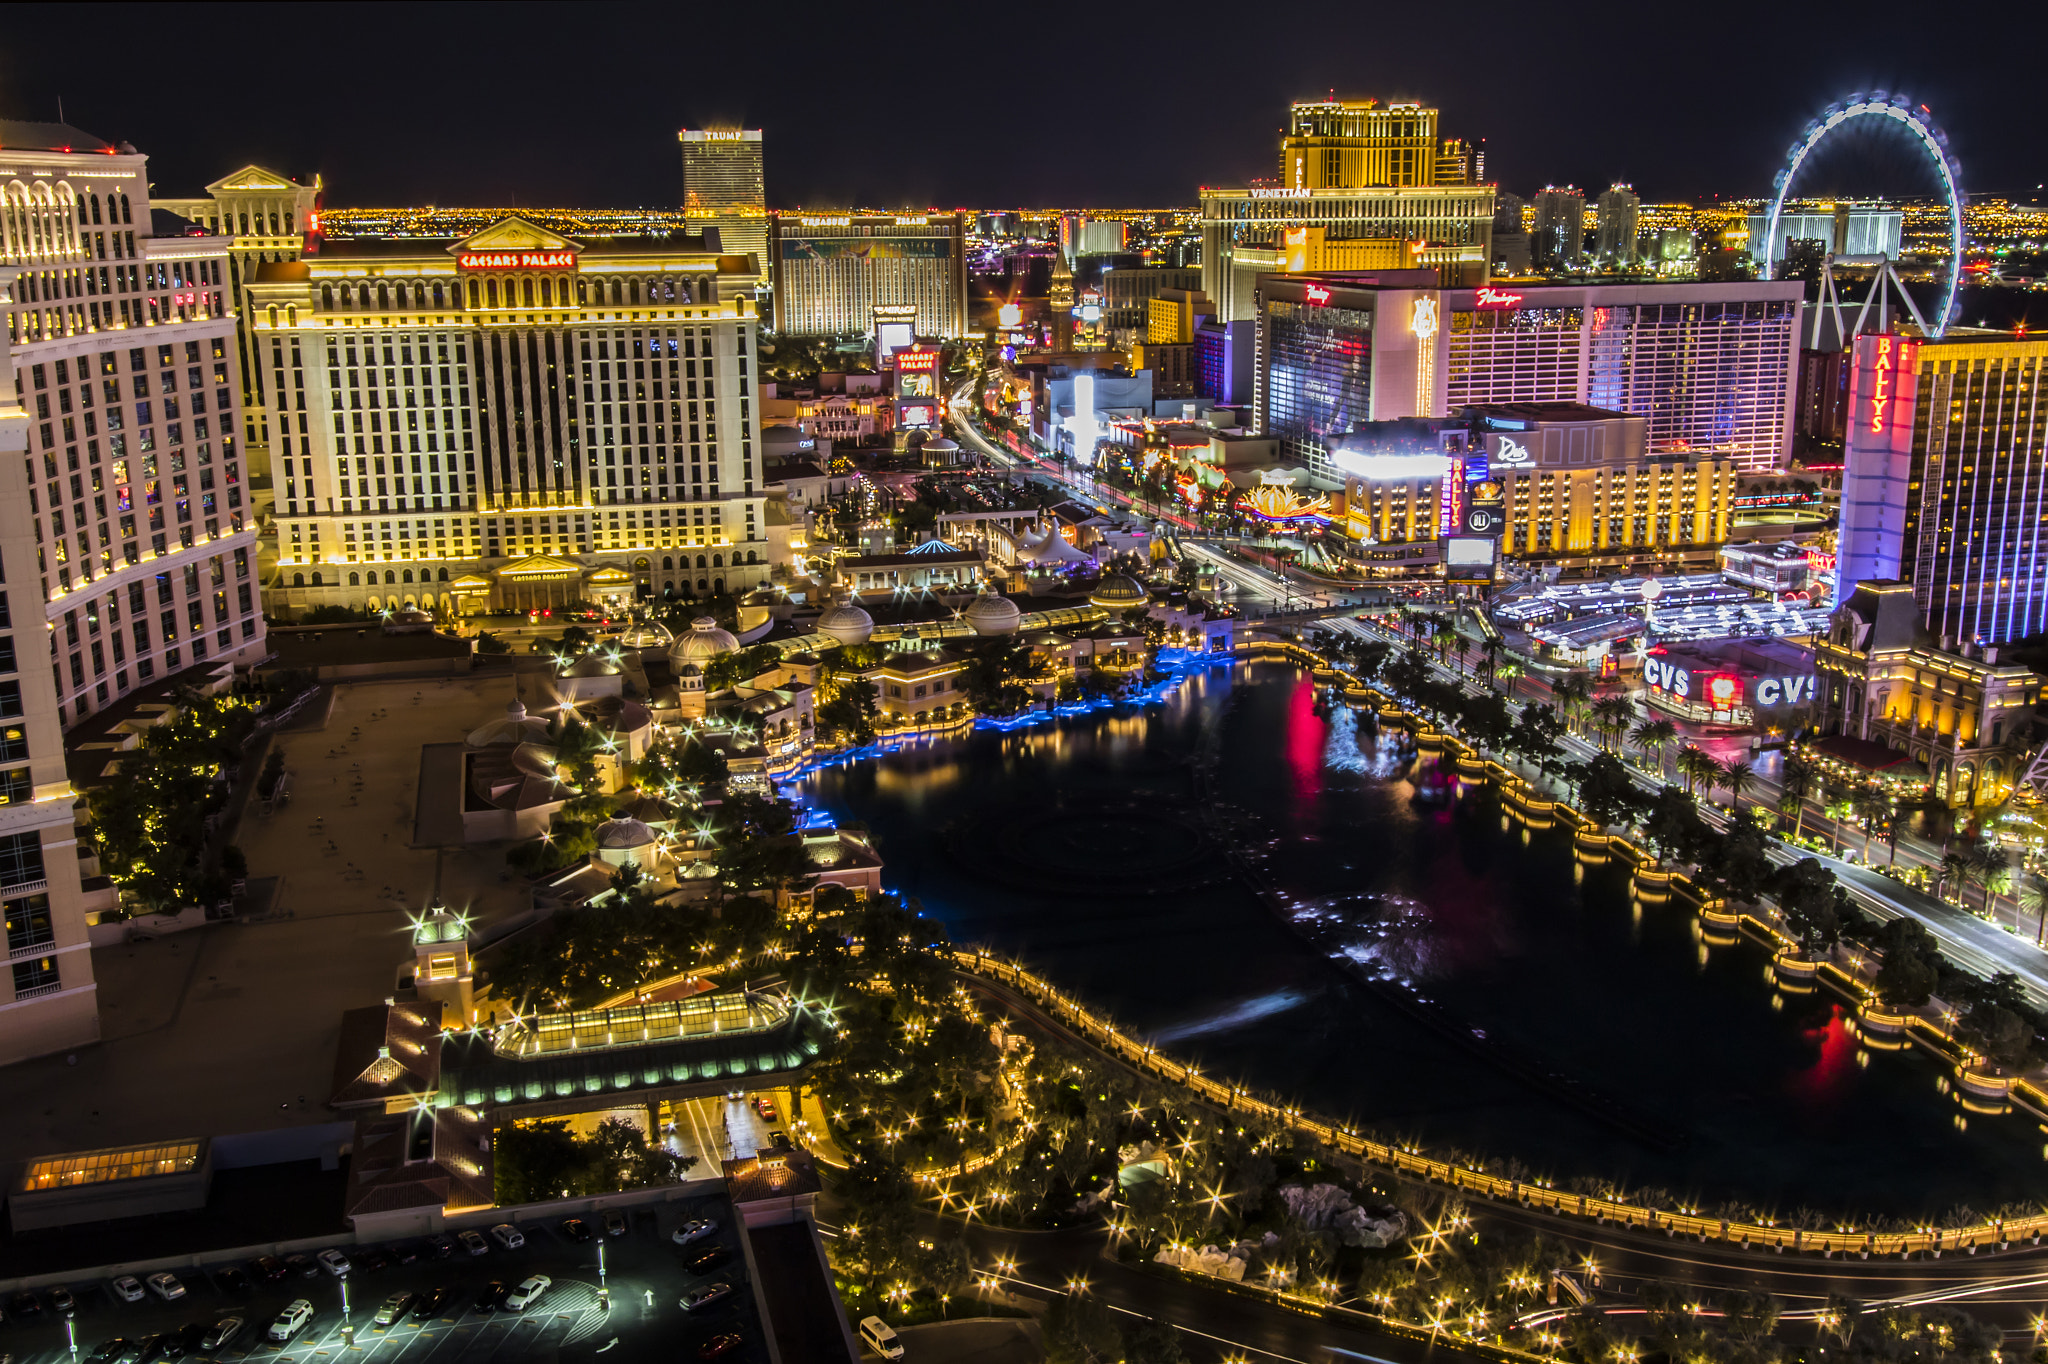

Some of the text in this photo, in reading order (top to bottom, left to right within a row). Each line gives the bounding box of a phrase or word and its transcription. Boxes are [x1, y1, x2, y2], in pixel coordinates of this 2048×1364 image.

[705, 132, 741, 141] TRUMP
[1251, 188, 1311, 198] VENETIAN
[801, 217, 851, 226] TREASURE
[461, 254, 573, 267] CAESARS PALACE
[1476, 288, 1522, 306] Flamingo
[898, 353, 934, 361] CAESARS
[900, 361, 933, 369] PALACE
[1473, 514, 1486, 527] BLT
[1644, 657, 1689, 697] CVS
